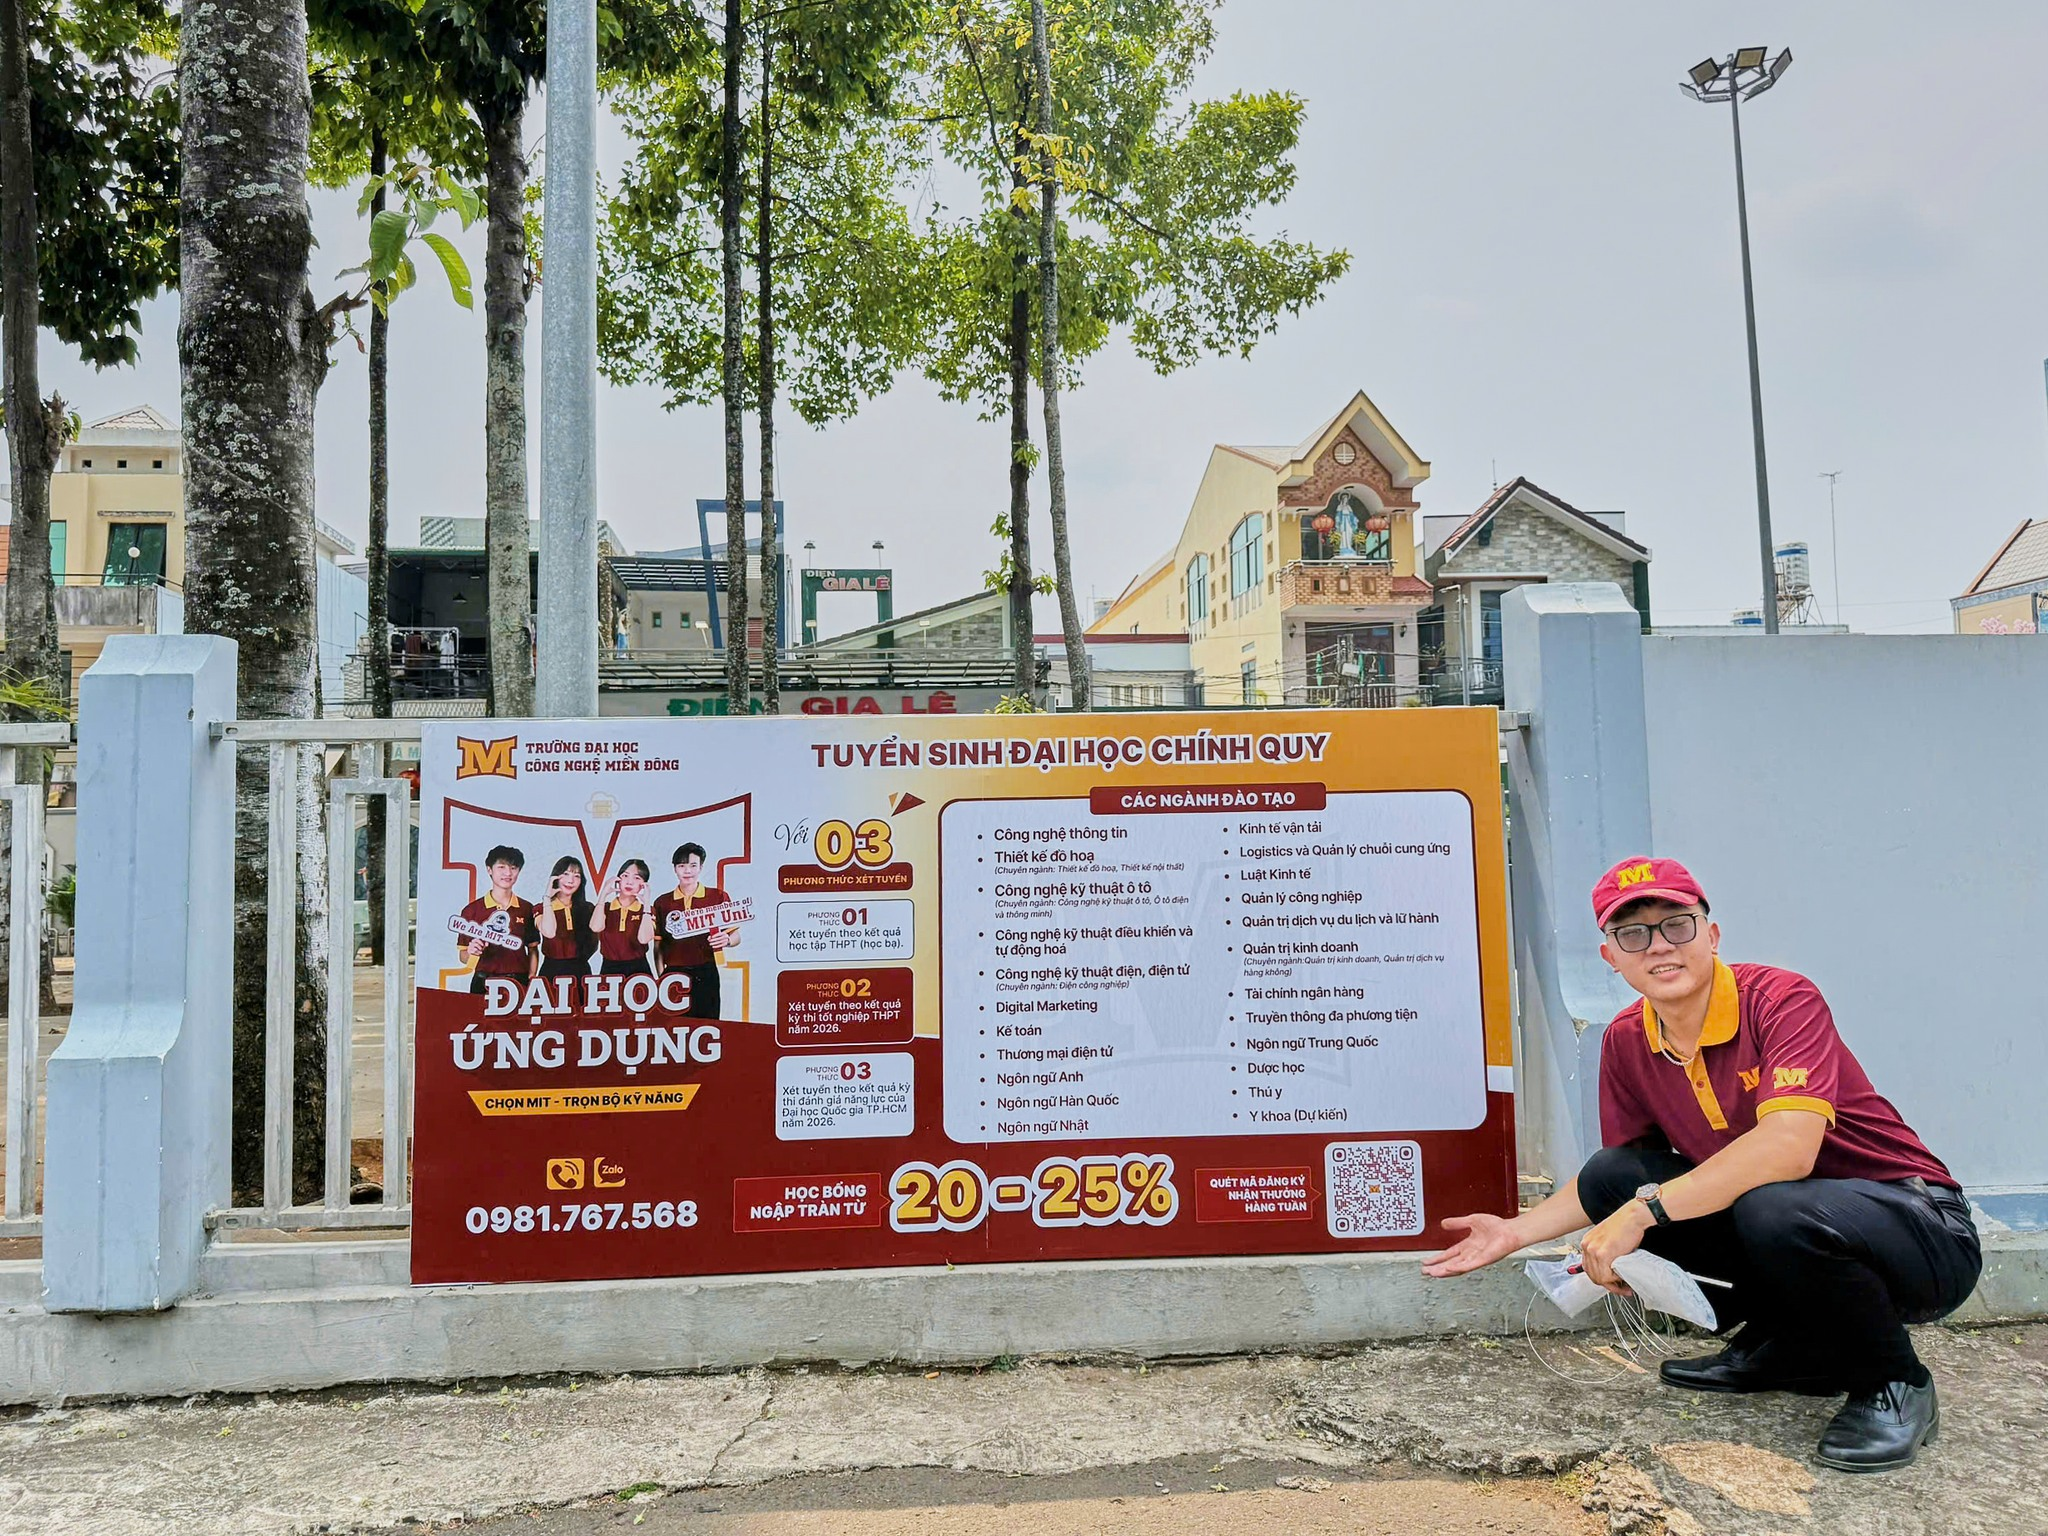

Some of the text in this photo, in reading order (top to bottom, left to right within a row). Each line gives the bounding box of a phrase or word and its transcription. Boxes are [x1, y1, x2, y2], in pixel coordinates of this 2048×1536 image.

[806, 570, 835, 579] ĐIỆN
[822, 574, 890, 590] GIA LÊ
[801, 696, 884, 715] GIA
[902, 691, 957, 714] LÊ
[525, 740, 639, 756] TRƯỜNG ĐẠI HỌC
[811, 731, 1327, 770] TUYỂN SINH ĐẠI HỌC CHÍNH QUY
[457, 735, 518, 780] M
[525, 755, 679, 774] CÔNG NGHỆ MIỀN ĐÔNG
[1121, 789, 1295, 808] CÁC NGÀNH ĐÀO TẠO
[994, 826, 1128, 844] Công nghệ thông tin
[1239, 821, 1322, 836] Kinh tế vận tải
[774, 818, 893, 868] Với 03
[1240, 845, 1293, 860] Logistics
[1295, 845, 1309, 856] và
[1312, 843, 1344, 856] Quản
[1347, 843, 1357, 858] lý
[1395, 845, 1425, 856] cung
[1427, 842, 1450, 856] ứng
[994, 849, 1028, 863] Thiết
[1032, 849, 1048, 863] kế
[1050, 849, 1067, 862] đồ
[784, 877, 825, 886] PHƯƠNG
[827, 874, 854, 885] THỨC
[856, 874, 875, 884] XÉT
[1241, 867, 1311, 883] Luật Kinh tế
[1617, 862, 1655, 890] M
[995, 881, 1152, 899] Công nghệ kỹ thuật ô tô
[686, 913, 715, 931] MIT
[842, 908, 868, 926] 01
[452, 920, 519, 947] We Are MIT-ers
[789, 929, 806, 939] Xét
[839, 929, 862, 938] theo
[864, 927, 880, 937] kết
[789, 941, 808, 952] học
[810, 939, 827, 951] tập
[829, 939, 857, 949] THPT
[860, 939, 882, 950] (học
[1243, 941, 1359, 956] Quản trị kinh doanh
[996, 963, 1191, 982] Công nghệ kỹ thuật điện, điện tử
[484, 974, 691, 1024] ĐẠI HỌC
[1245, 986, 1364, 1001] Tài chính ngân hàng
[996, 999, 1098, 1015] Digital Marketing
[997, 1024, 1042, 1037] Kế toán
[450, 1024, 721, 1075] ỨNG DỤNG
[997, 1045, 1114, 1062] Thương mại điện tử
[1248, 1062, 1305, 1076] Dược học
[997, 1071, 1084, 1087] Ngôn ngữ Anh
[1773, 1067, 1808, 1089] M
[485, 1098, 524, 1111] CHỌN
[527, 1096, 551, 1108] MIT
[562, 1096, 600, 1109] TRỌN
[602, 1092, 621, 1108] BỘ
[623, 1091, 642, 1105] KỸ
[645, 1091, 683, 1104] NĂNG
[1248, 1086, 1283, 1100] Thú y
[1249, 1108, 1347, 1123] Y khoa (Dự kiến)
[602, 1165, 624, 1174] Zalo
[1210, 1176, 1238, 1188] QUÉT
[1240, 1175, 1257, 1187] MÃ
[1258, 1175, 1289, 1187] ĐĂNG
[785, 1181, 867, 1202] HỌC BỔNG
[1228, 1187, 1306, 1202] NHẬN THƯỞNG
[750, 1199, 867, 1221] NGẬP TRÀN TỪ
[1245, 1200, 1307, 1213] HÀNG TUẦN
[465, 1200, 698, 1234] 0981.767.568
